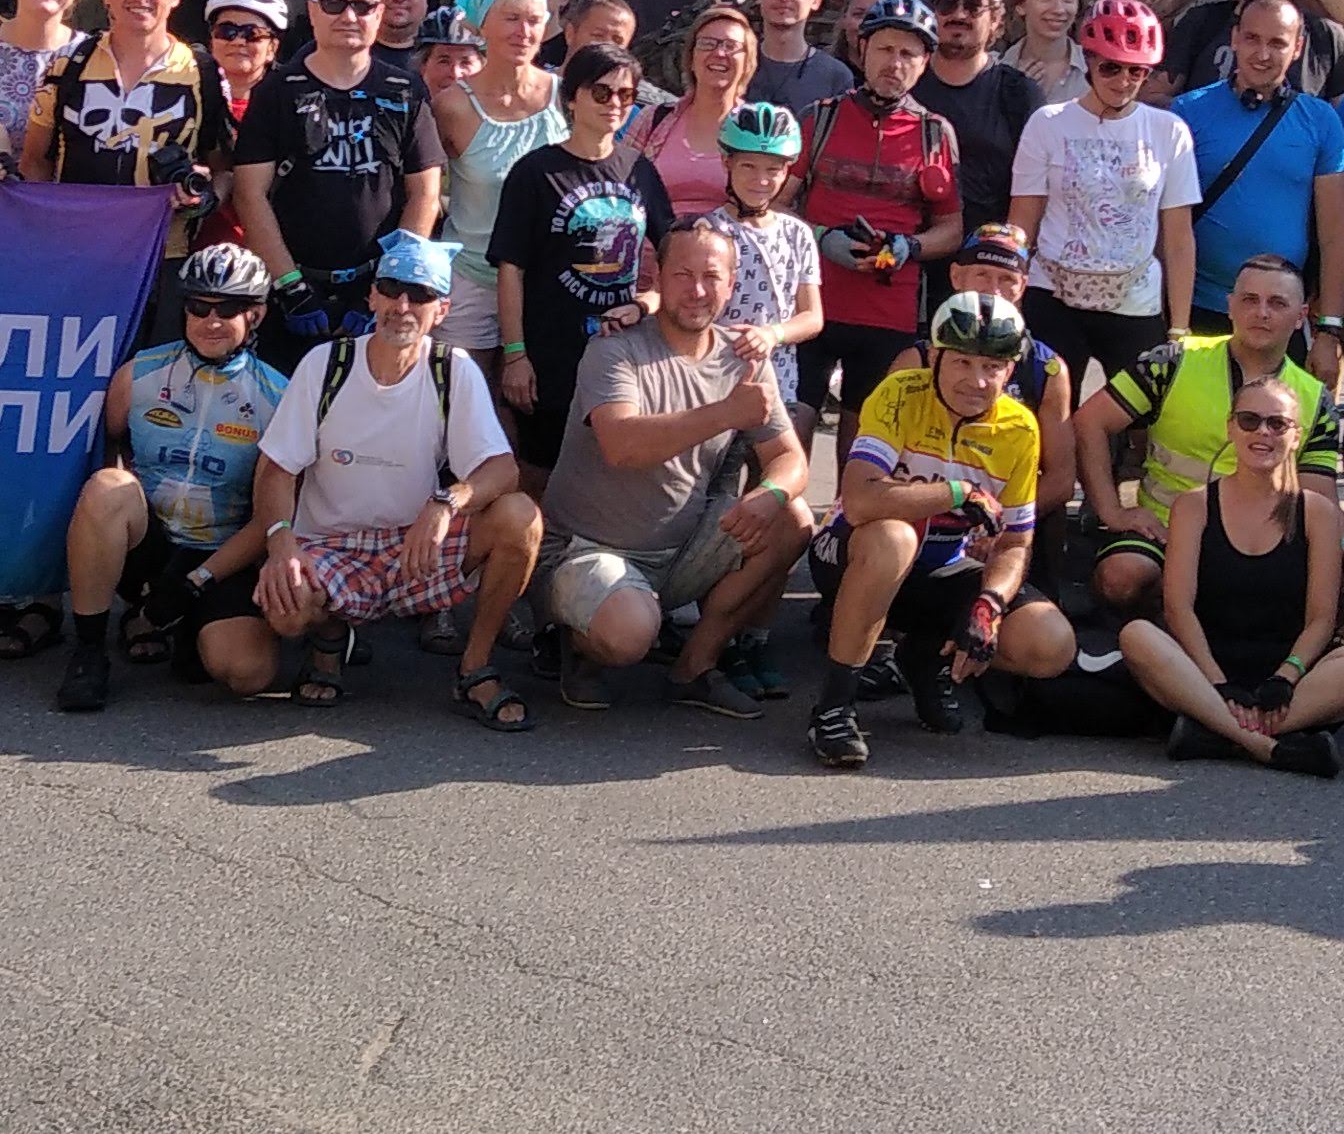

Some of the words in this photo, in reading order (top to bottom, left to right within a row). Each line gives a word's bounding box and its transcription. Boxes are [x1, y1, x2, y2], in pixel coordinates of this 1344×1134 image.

[977, 251, 1019, 268] GARMIN
[558, 269, 589, 300] RICK
[589, 289, 615, 306] AND
[214, 422, 260, 439] BONUS
